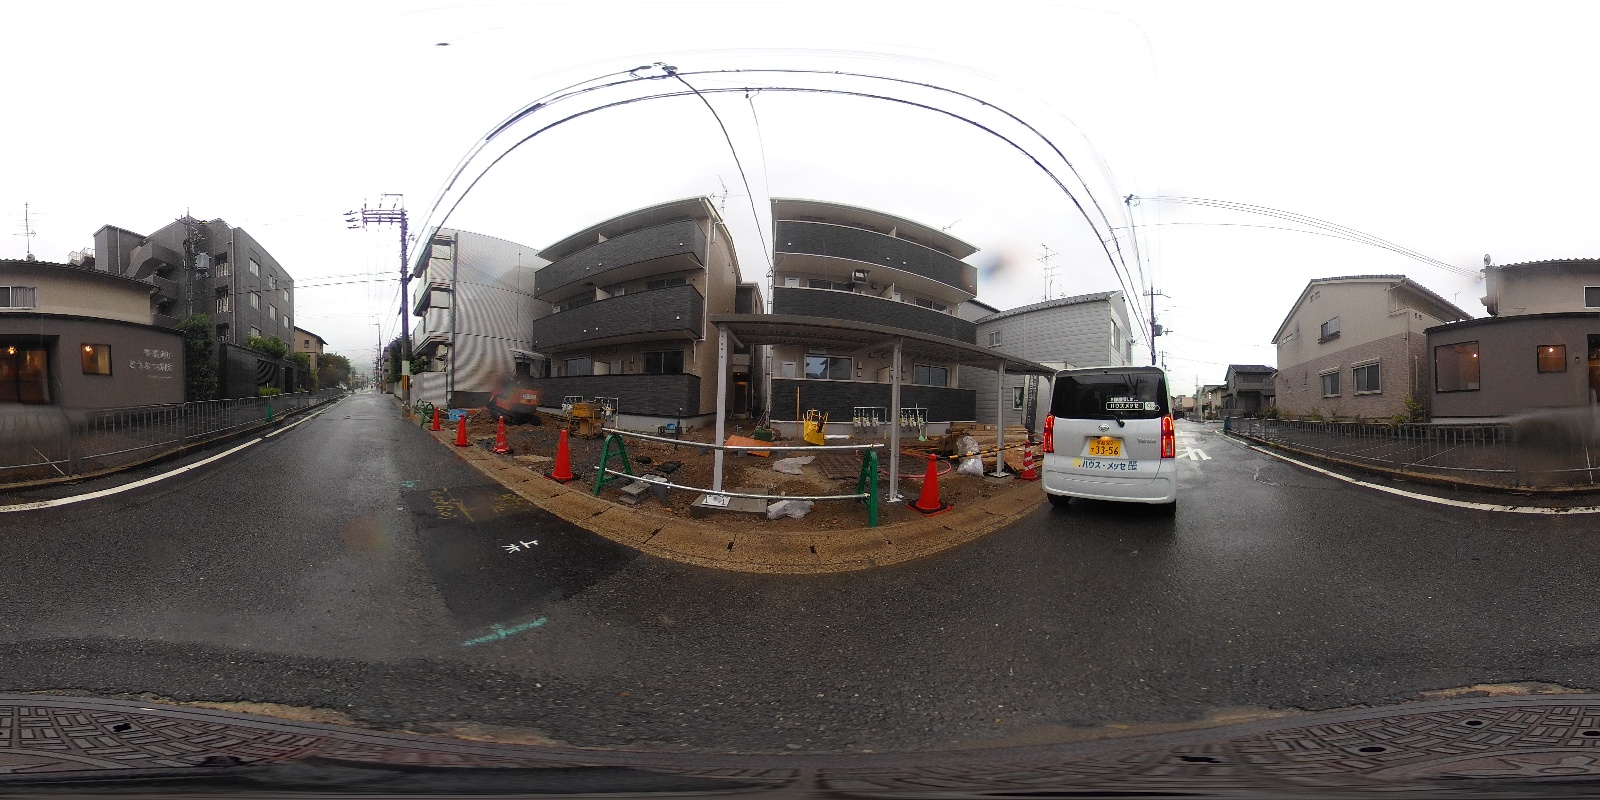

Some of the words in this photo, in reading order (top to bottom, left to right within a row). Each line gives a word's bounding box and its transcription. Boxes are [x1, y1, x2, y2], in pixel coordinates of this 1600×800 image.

[1082, 460, 1126, 471] ハウス・メッセ
